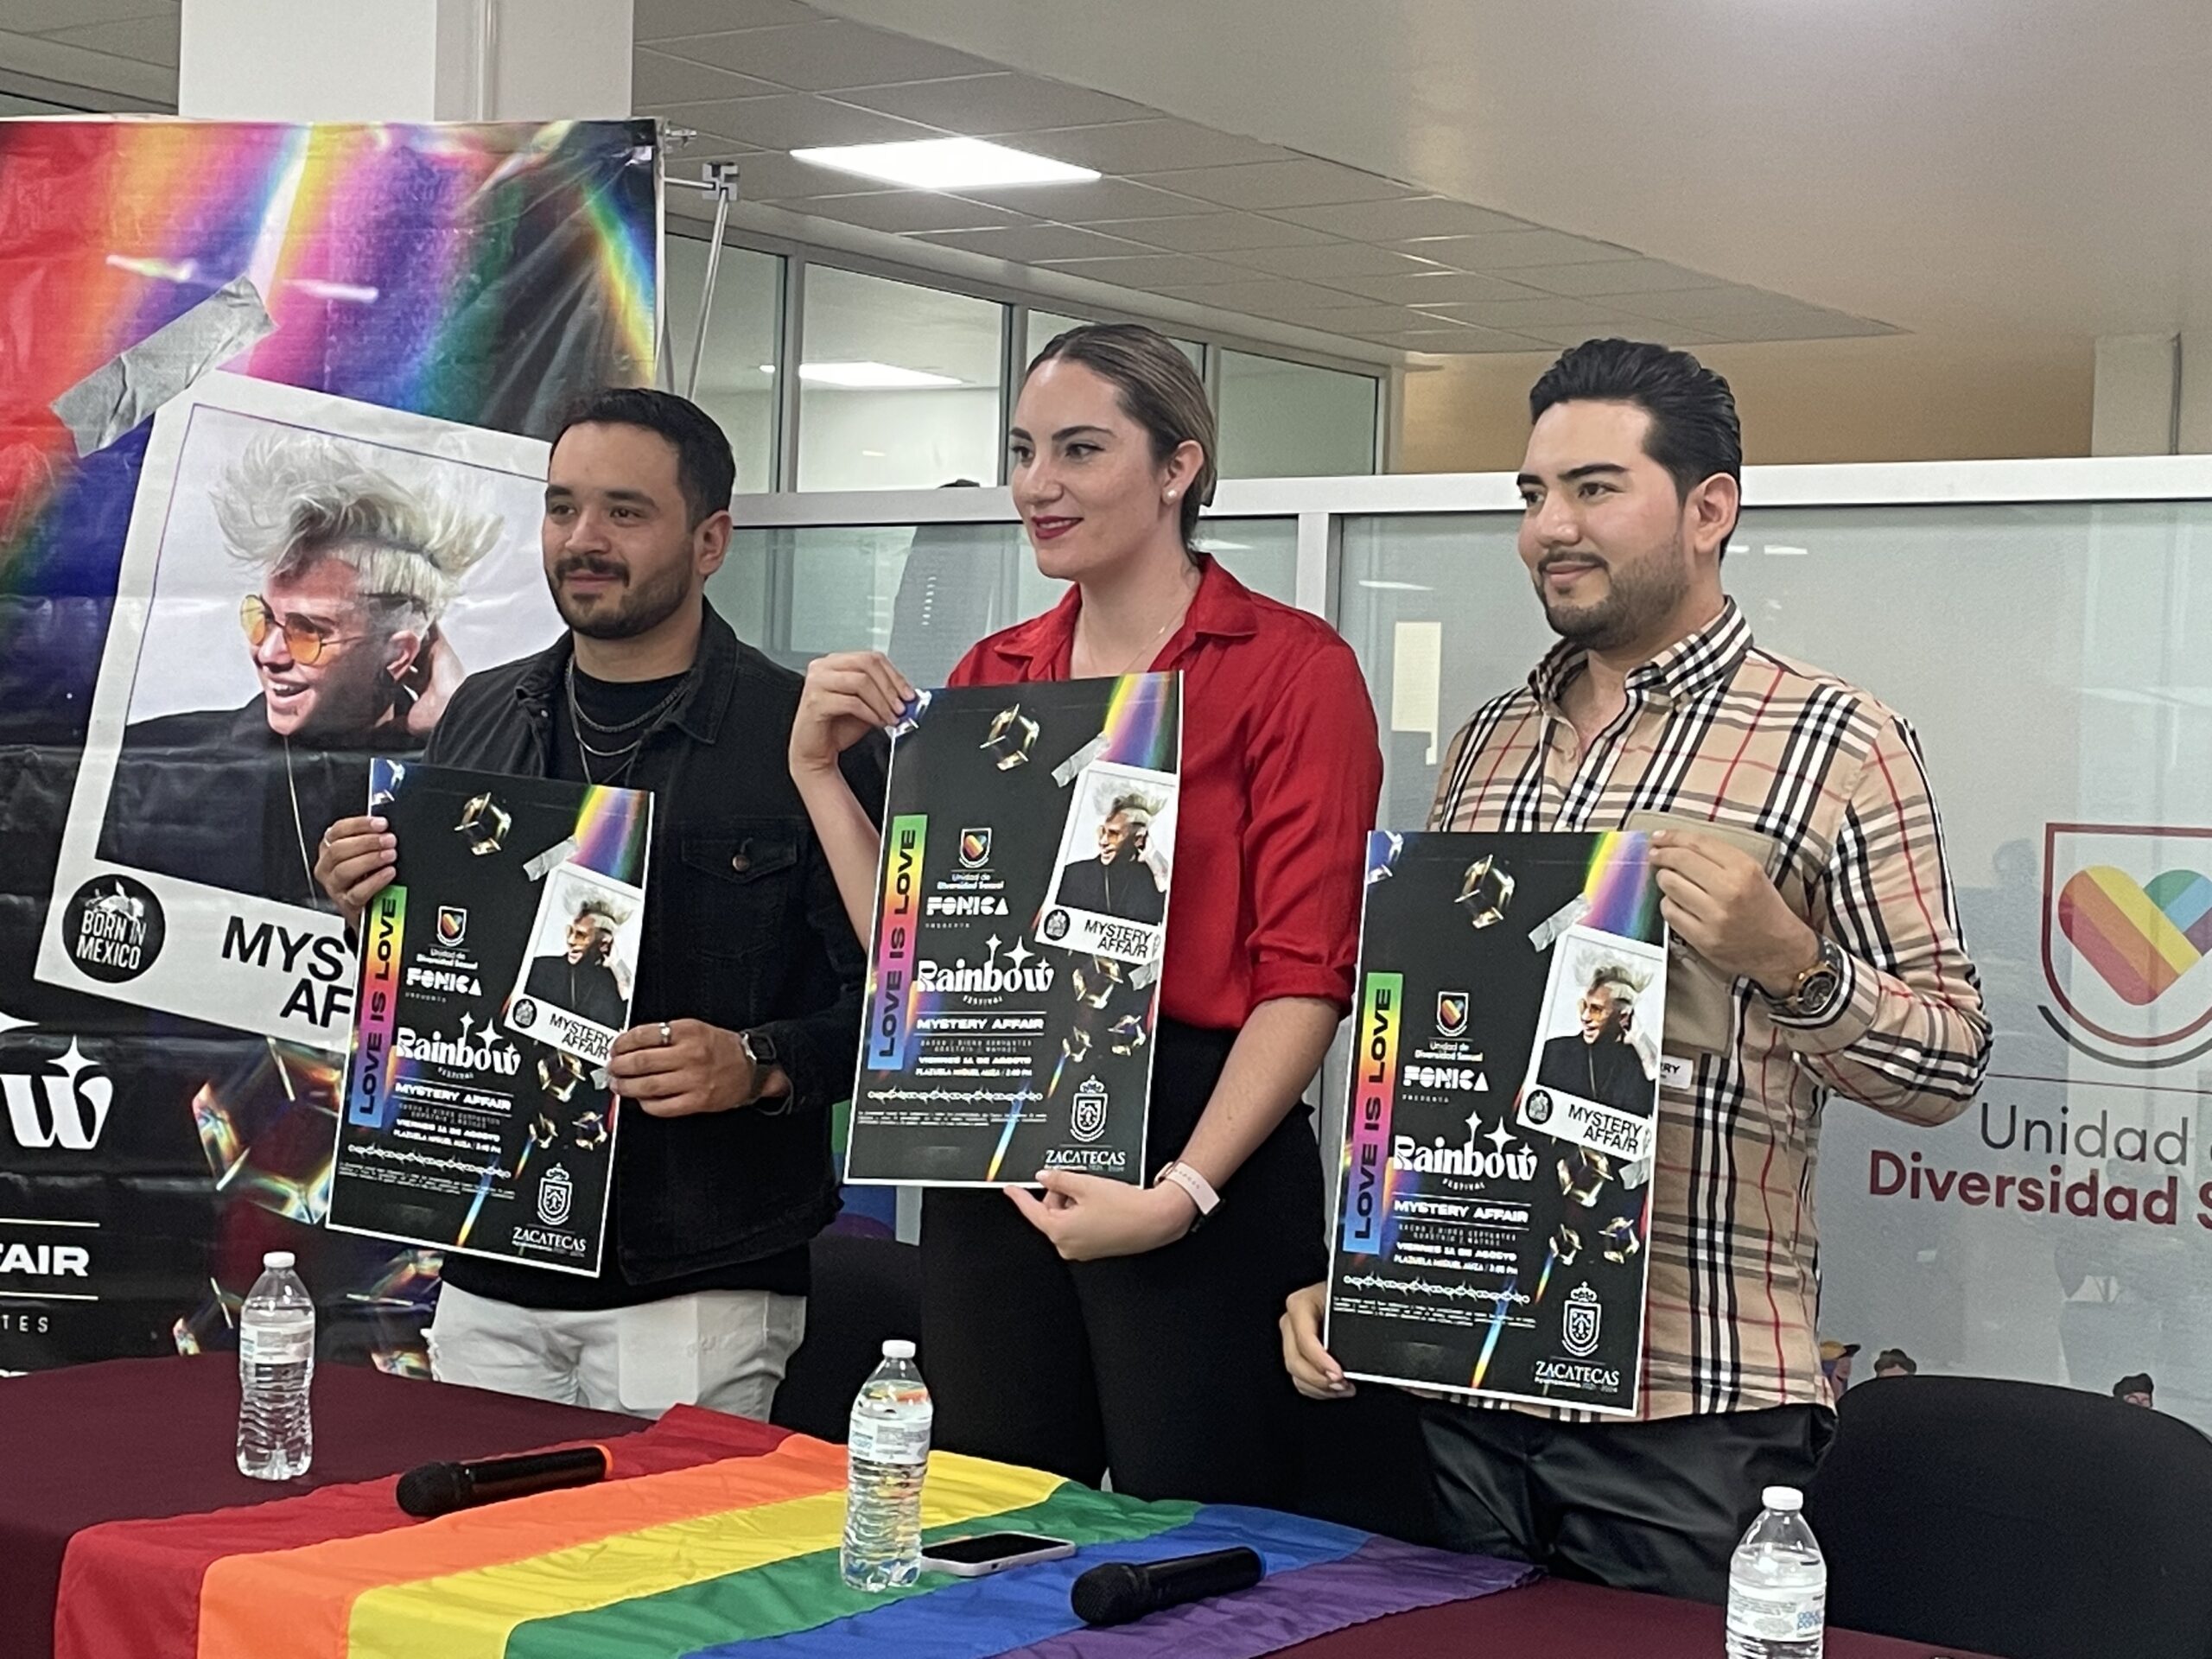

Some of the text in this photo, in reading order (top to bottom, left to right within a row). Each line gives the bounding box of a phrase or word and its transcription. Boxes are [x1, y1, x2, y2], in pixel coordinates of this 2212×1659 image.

[81, 910, 147, 946] BORN IN
[879, 830, 916, 1057] LOVE IS LOVE
[1084, 919, 1154, 944] MYSTERY
[76, 935, 142, 970] MEXICO
[1097, 937, 1148, 958] AFFAIR
[917, 944, 1054, 992] Rainbow
[359, 898, 396, 1115] LOVE IS LOVE
[550, 1014, 614, 1046] MYSTERY
[917, 1019, 1044, 1029] MYSTERY AFFAIR
[396, 1021, 521, 1075] Rainbow
[562, 1033, 608, 1060] AFFAIR
[395, 1082, 512, 1110] MYSTERY AFFAIR
[1355, 988, 1391, 1239] LOVE IS LOVE
[1568, 1104, 1643, 1139] MYSTERY
[1393, 1121, 1538, 1180] Rainbow
[1583, 1125, 1638, 1154] AFFAIR
[1980, 1103, 2188, 1166] Unidad
[1046, 1150, 1126, 1166] ZACATECAS
[1869, 1149, 2178, 1225] Diversidad
[1394, 1199, 1529, 1223] MYSTERY AFFAIR
[513, 1227, 587, 1251] ZACATECAS
[0, 1243, 90, 1276] AIR
[1535, 1361, 1620, 1386] ZACATECAS
